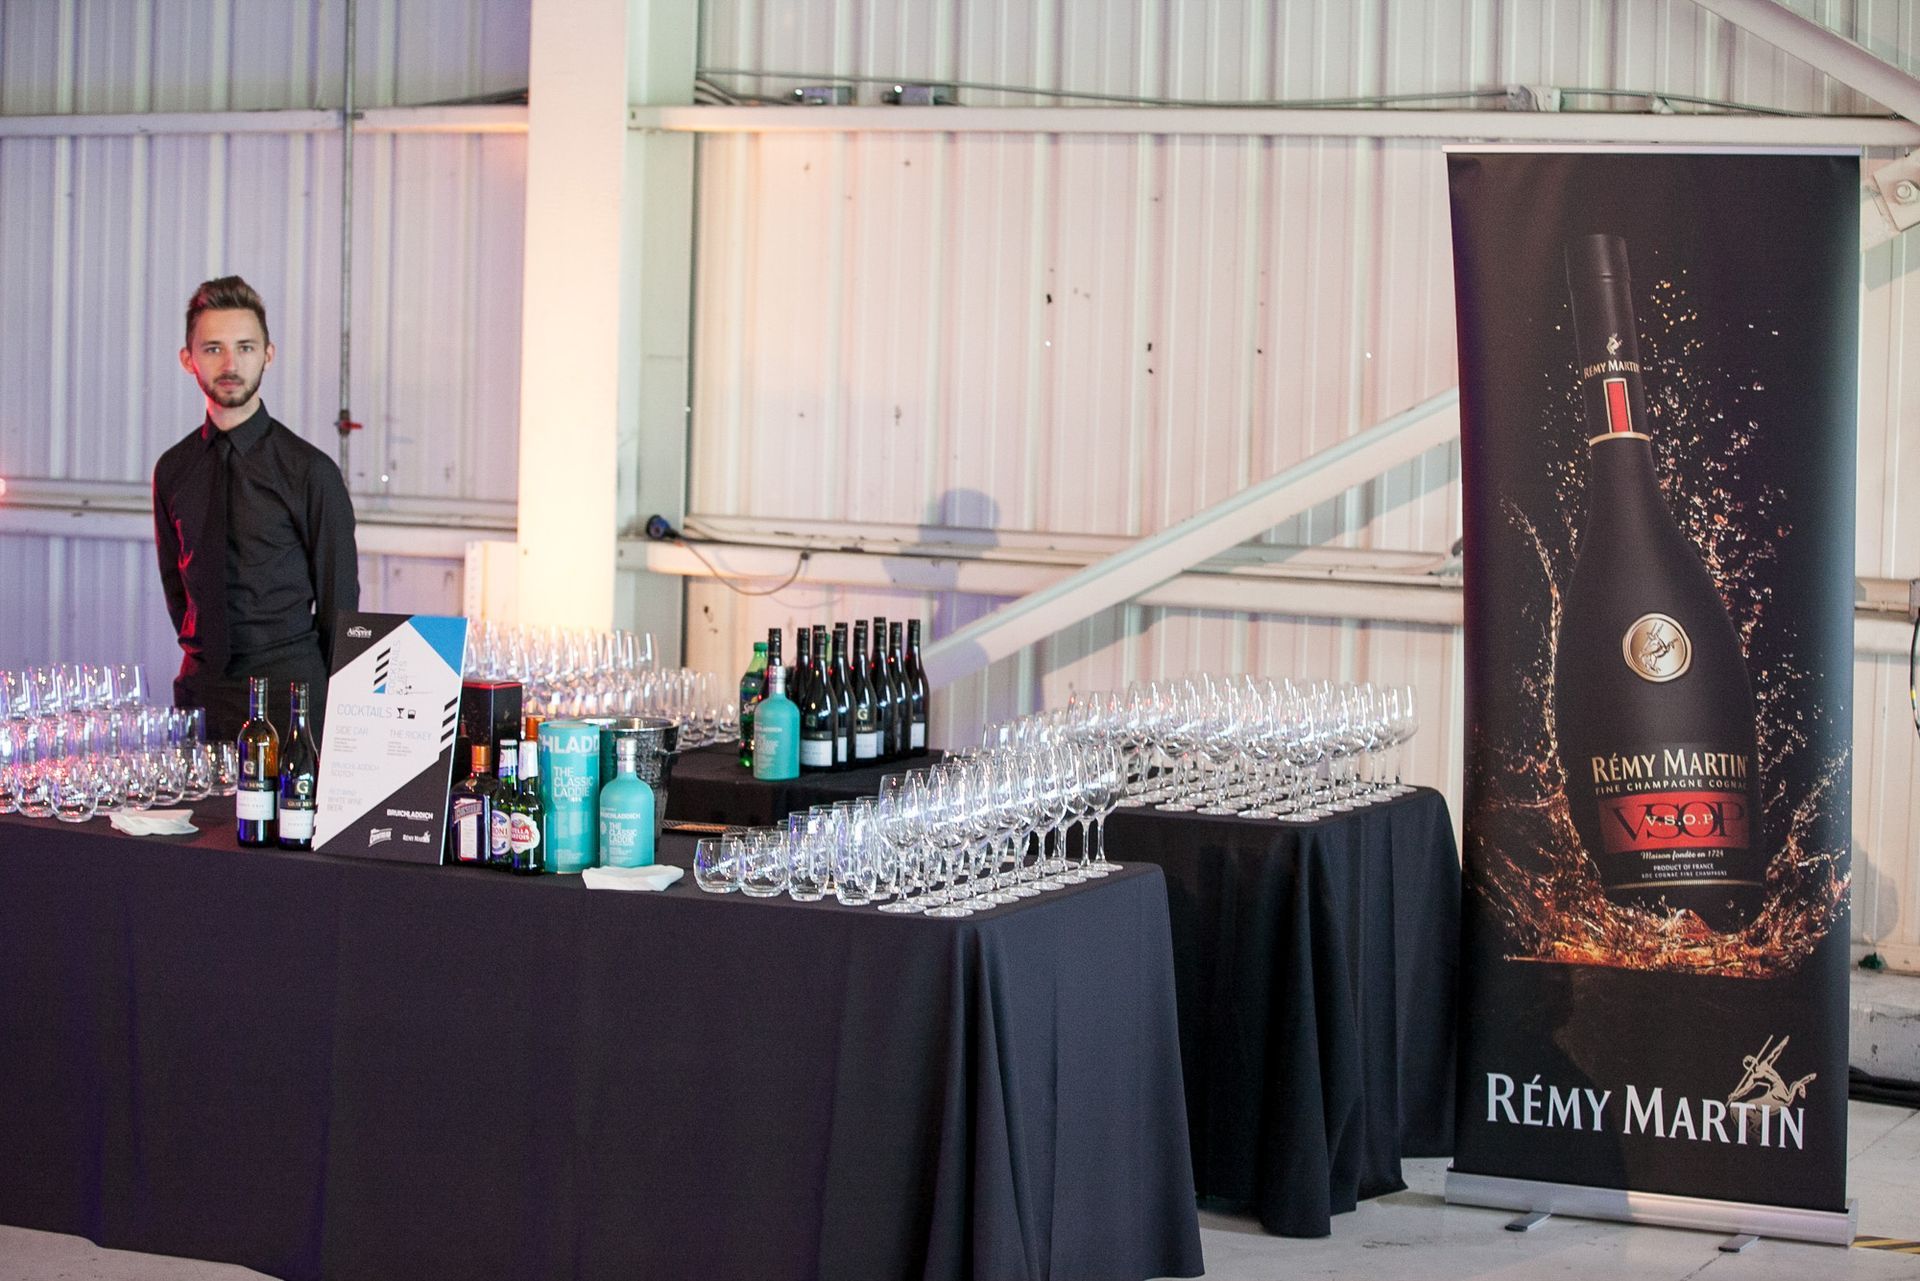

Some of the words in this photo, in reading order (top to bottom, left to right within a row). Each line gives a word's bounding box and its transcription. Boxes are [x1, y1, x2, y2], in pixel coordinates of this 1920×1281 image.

[337, 704, 393, 719] COCKTAILS
[390, 729, 404, 739] THE
[553, 766, 575, 777] THE
[1591, 752, 1657, 784] RÉMY
[1663, 748, 1748, 779] MARTIN
[553, 776, 594, 787] CLASSIC
[1595, 785, 1621, 796] FINE
[1626, 780, 1703, 792] CHAMPAGNE
[1708, 778, 1748, 790] COGNAC
[553, 787, 590, 797] LADDIE
[1640, 851, 1671, 860] Maison
[1671, 850, 1696, 861] fondée
[1653, 864, 1682, 872] PRODUCT
[1486, 1072, 1613, 1132] RÉMY
[1622, 1084, 1805, 1150] MARTIN
